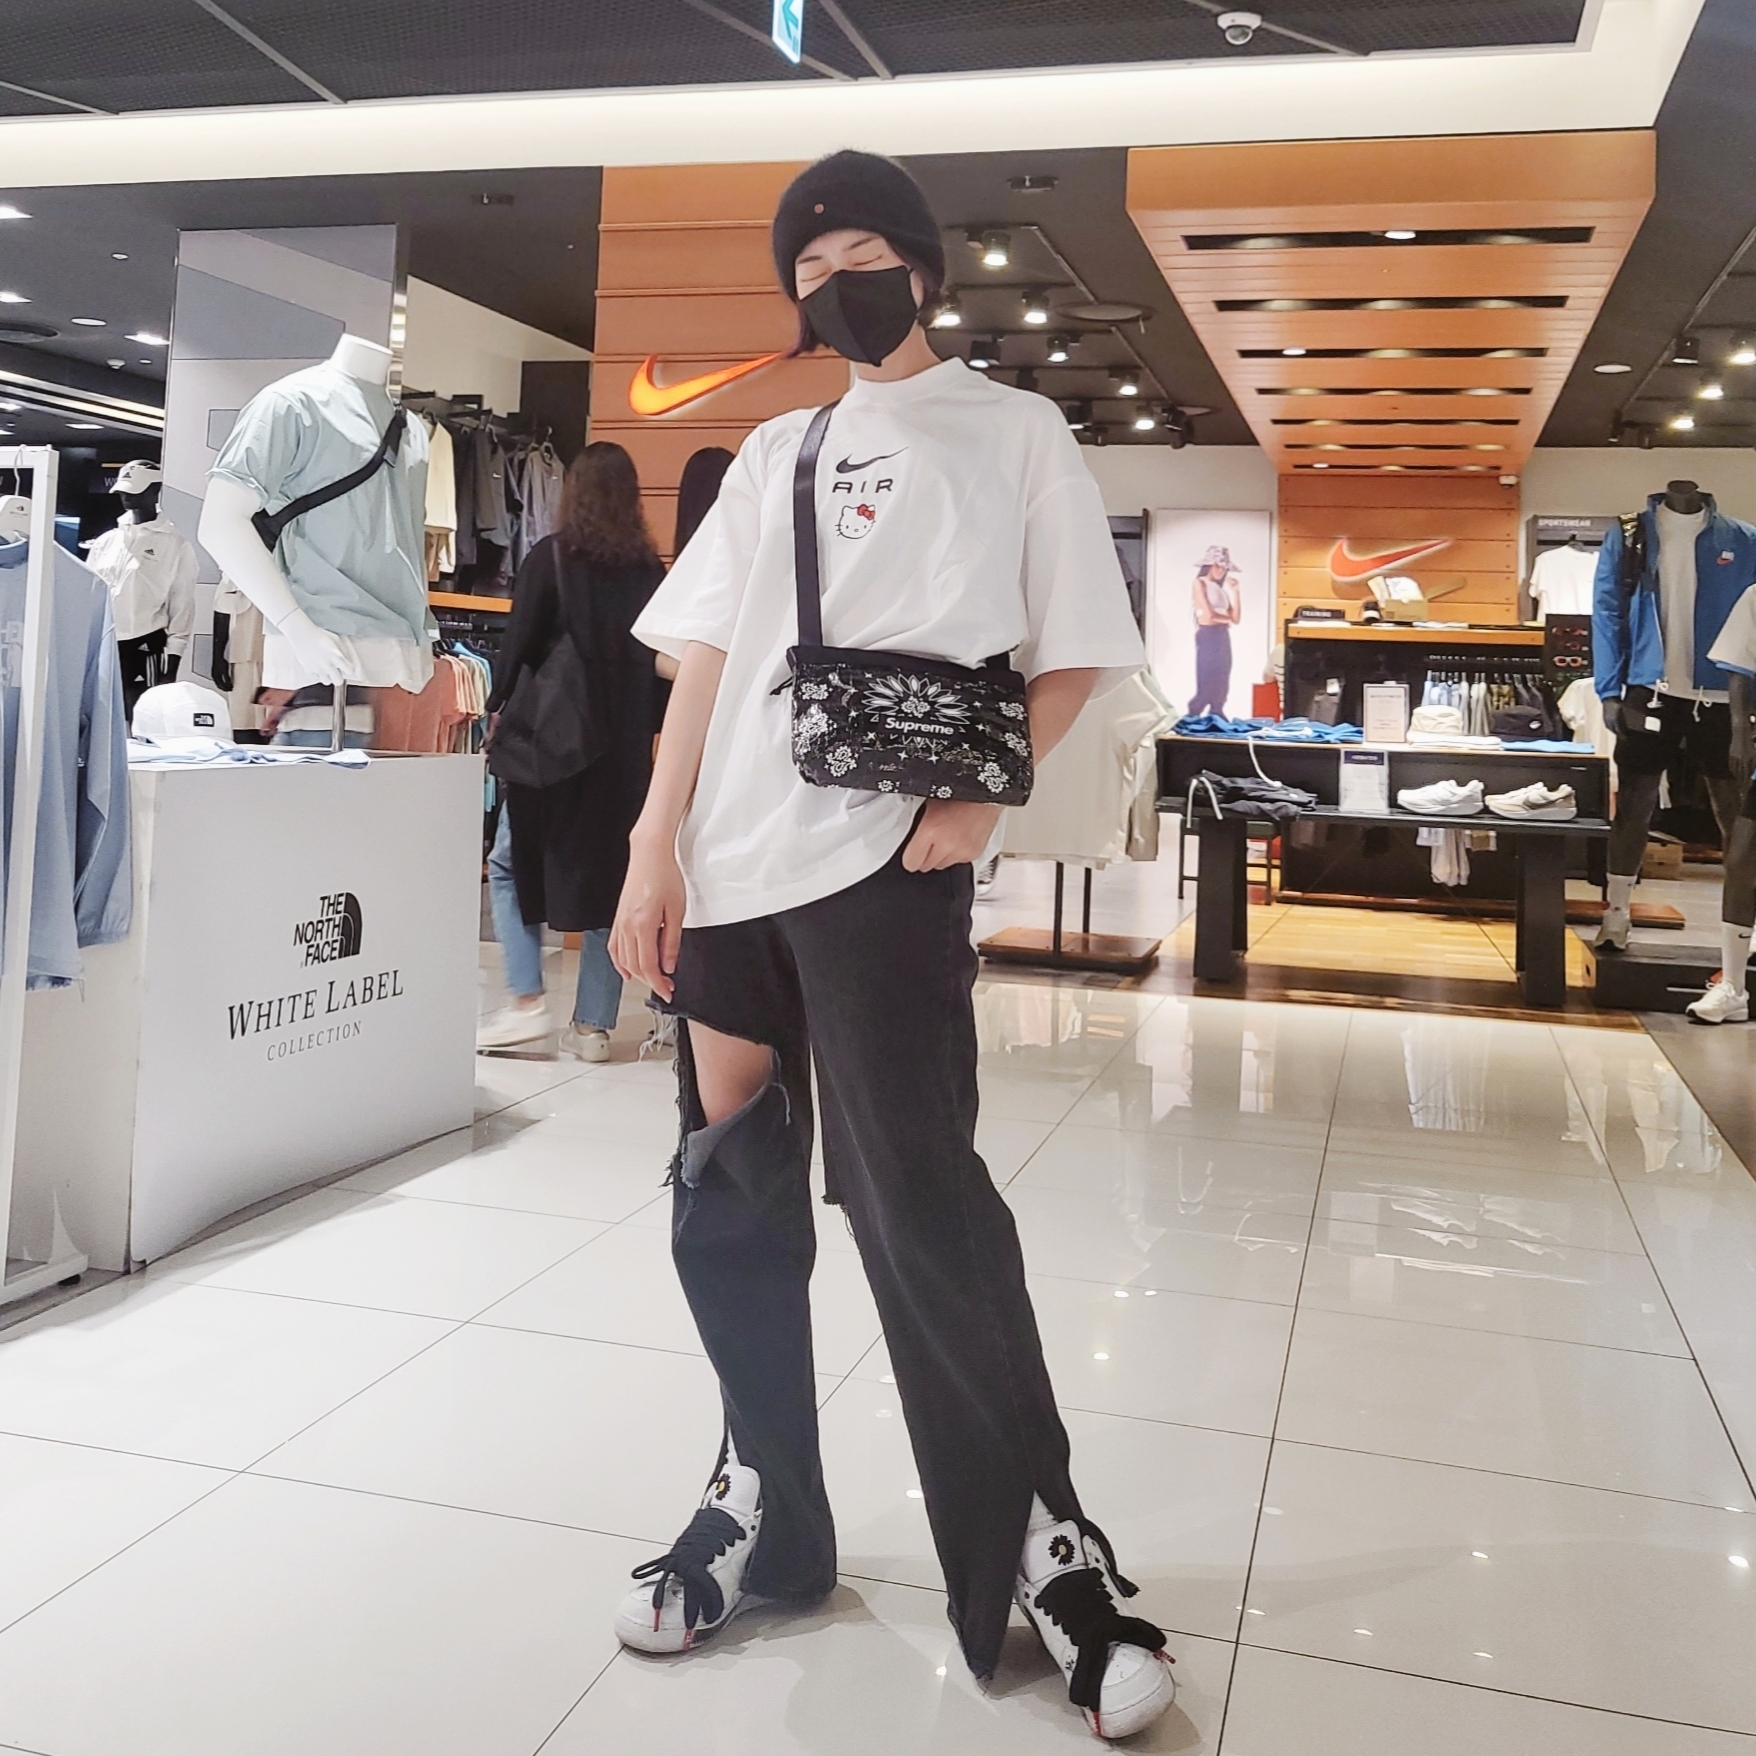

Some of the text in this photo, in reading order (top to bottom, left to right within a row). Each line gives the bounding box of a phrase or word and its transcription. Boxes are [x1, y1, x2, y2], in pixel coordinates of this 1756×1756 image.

[832, 478, 894, 494] AIR
[1538, 518, 1591, 527] SPORTSWEAR
[885, 717, 954, 735] Supreme
[319, 892, 345, 918] THE
[293, 916, 342, 947] NORTH
[304, 939, 339, 967] FACE
[228, 970, 404, 1040] WHITE LABEL
[267, 1020, 361, 1061] COLLECTION
